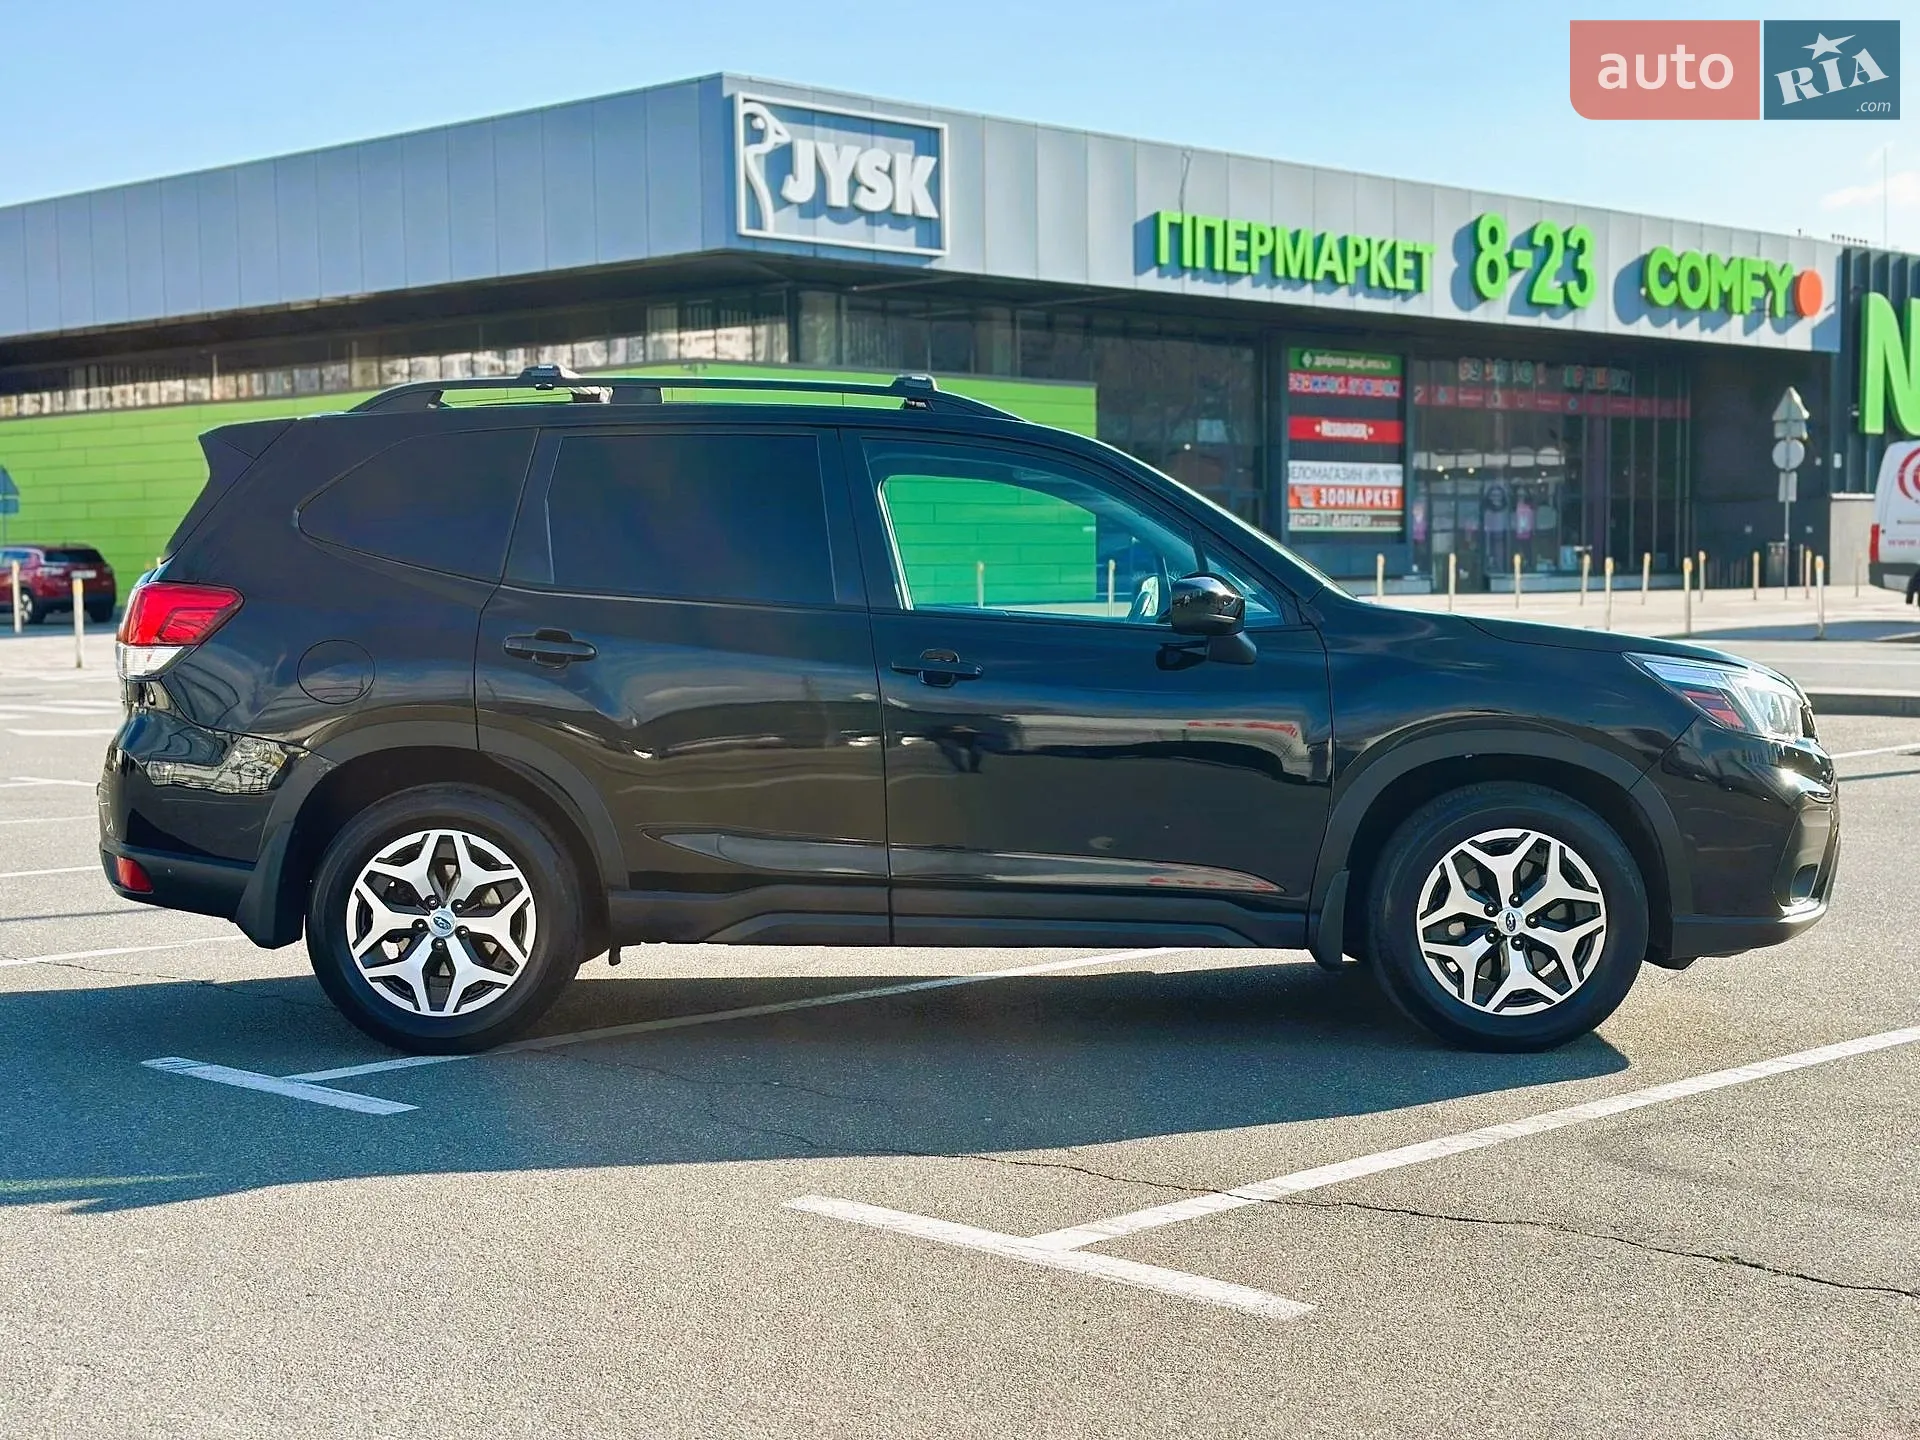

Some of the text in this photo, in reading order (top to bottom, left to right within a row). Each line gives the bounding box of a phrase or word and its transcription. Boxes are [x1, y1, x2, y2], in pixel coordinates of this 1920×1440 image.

[781, 139, 939, 218] JYSK
[1156, 211, 1597, 309] ГІПЕРМАРКЕТ 8-23
[1646, 246, 1794, 318] COMFY
[1319, 487, 1398, 508] ЗООМАРКЕТ
